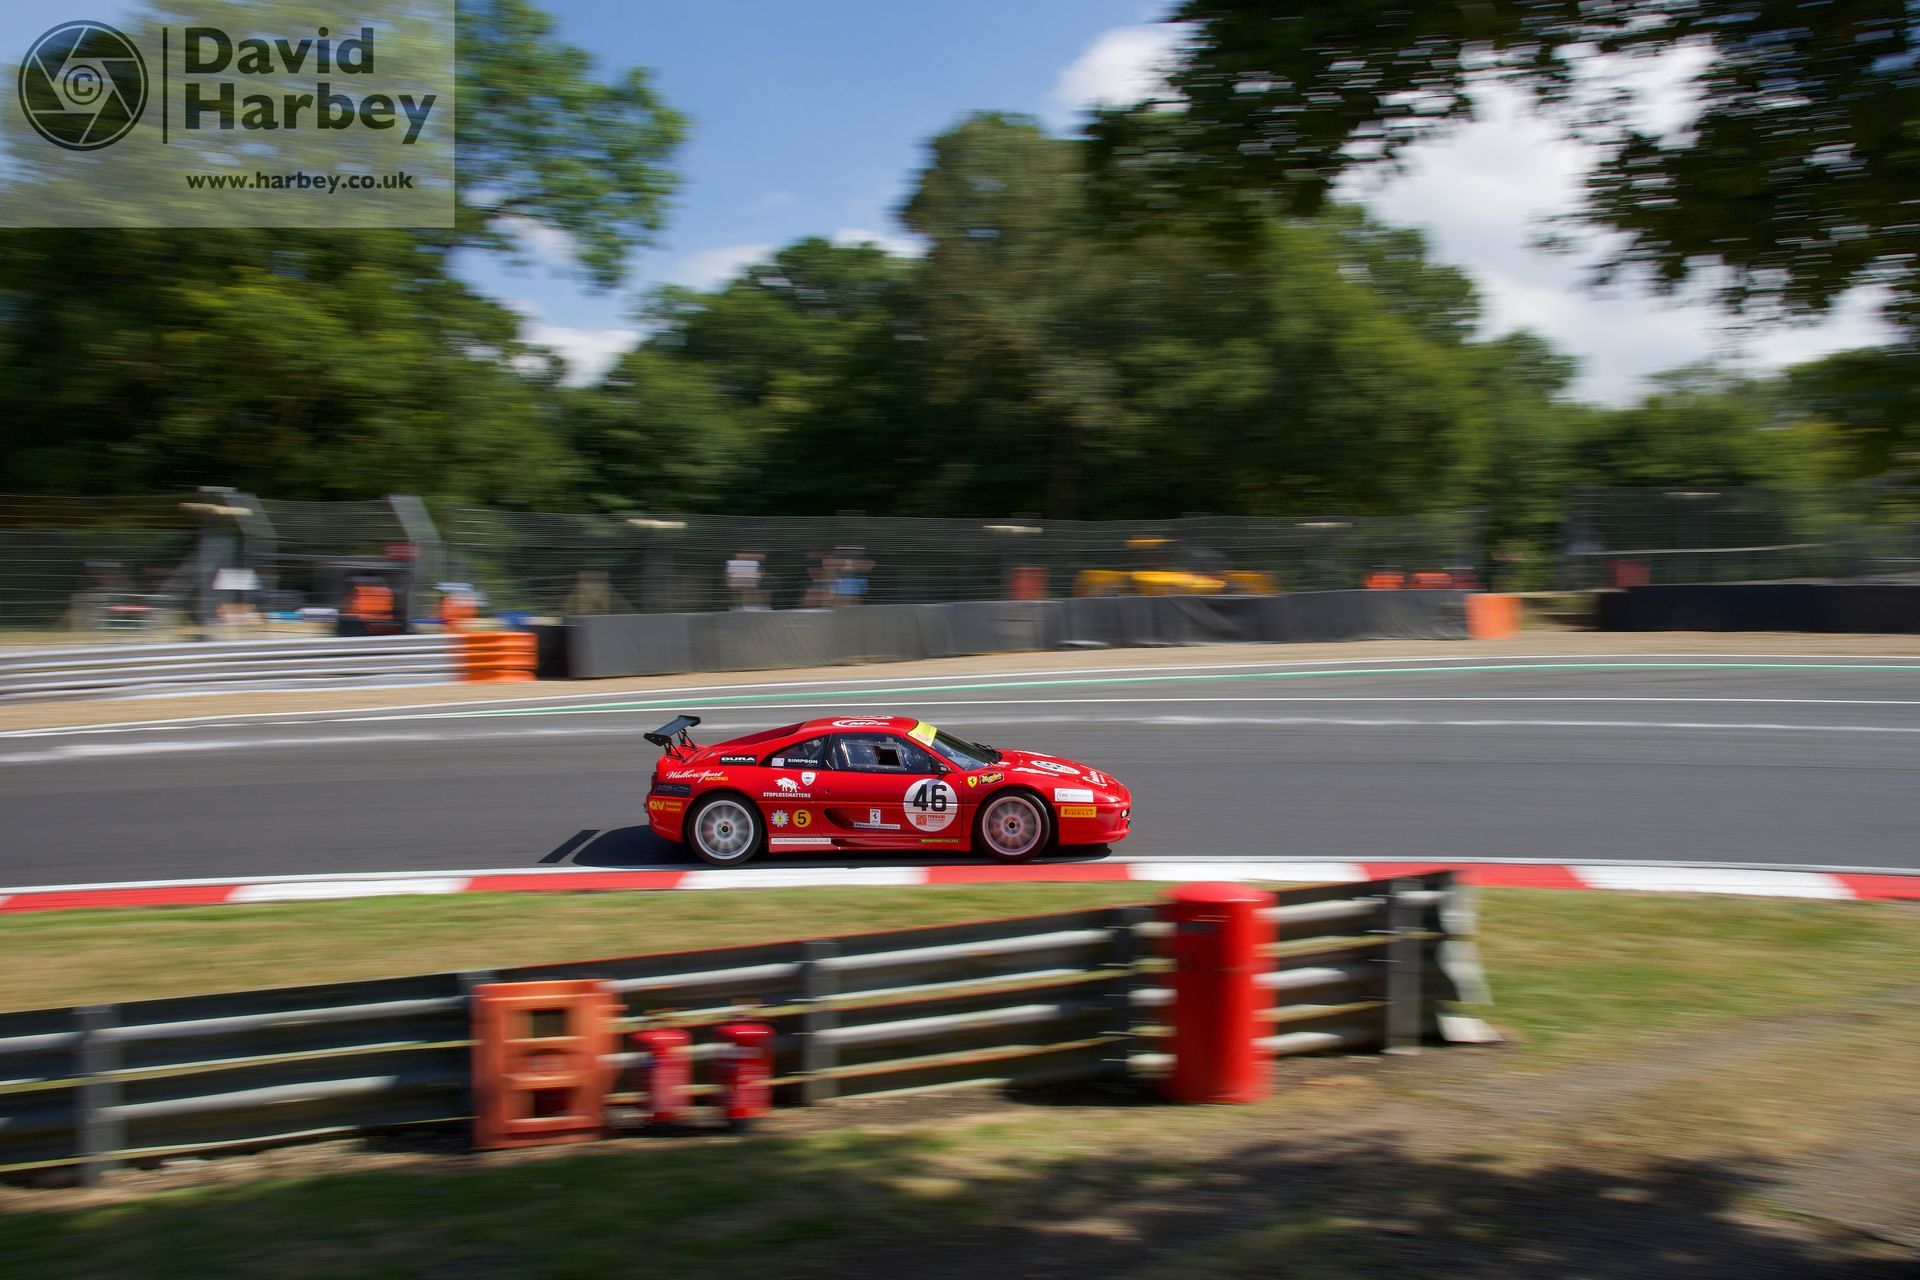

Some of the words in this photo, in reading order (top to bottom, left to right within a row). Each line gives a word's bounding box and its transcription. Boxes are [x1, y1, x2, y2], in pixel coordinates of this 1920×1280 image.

[912, 784, 948, 812] 46
[650, 801, 665, 811] QV
[1064, 808, 1094, 816] PIRELLI
[797, 812, 807, 825] 5
